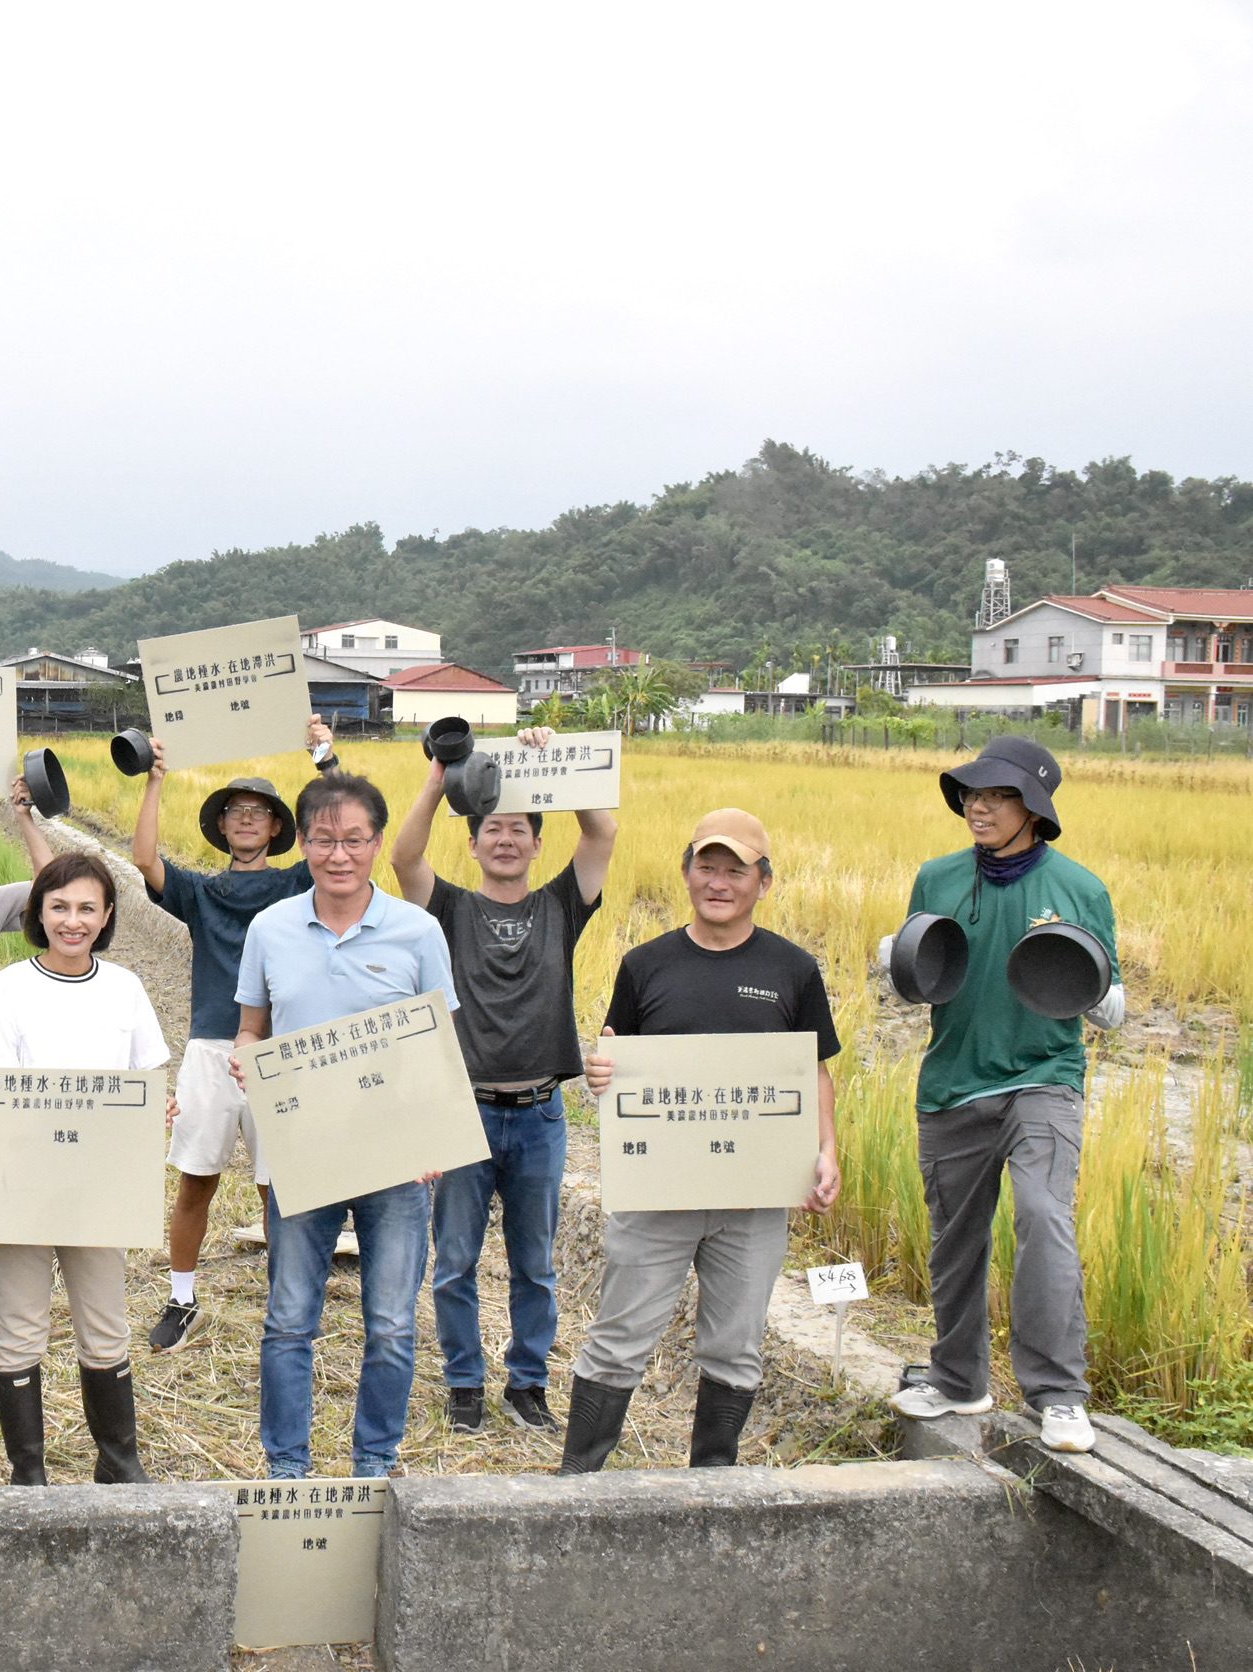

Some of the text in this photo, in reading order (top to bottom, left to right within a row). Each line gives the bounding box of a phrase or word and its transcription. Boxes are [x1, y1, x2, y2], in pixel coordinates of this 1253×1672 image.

[501, 766, 568, 779] 濃農村田野學會
[818, 1268, 856, 1287] 5468
